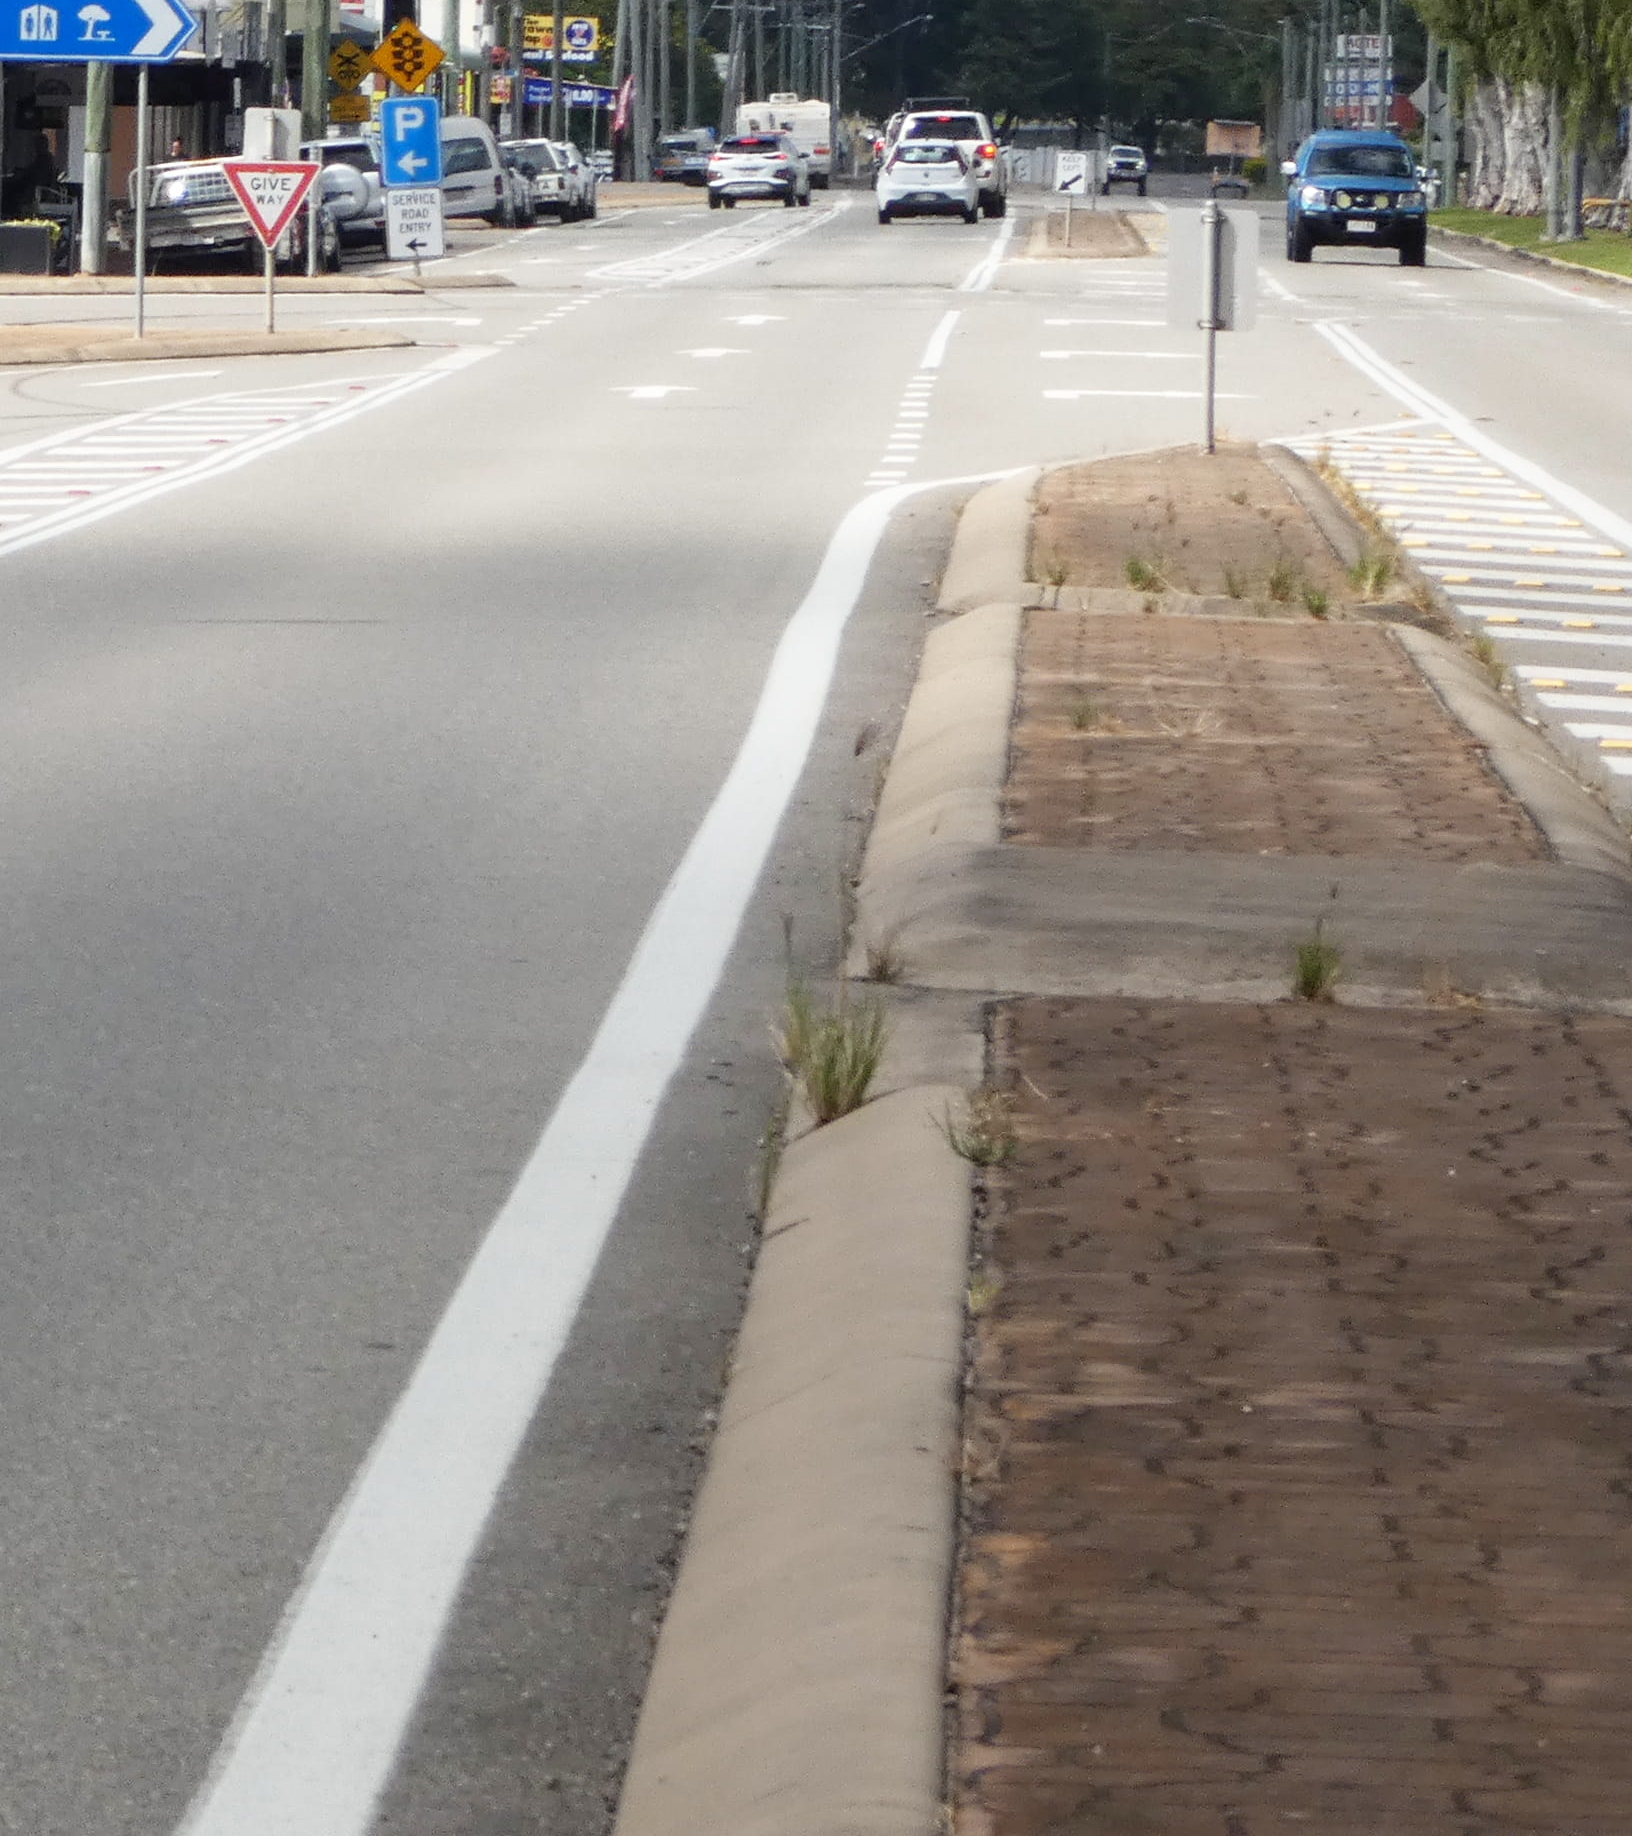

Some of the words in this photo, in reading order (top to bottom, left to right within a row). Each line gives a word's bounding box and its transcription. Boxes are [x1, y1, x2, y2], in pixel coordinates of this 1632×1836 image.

[394, 107, 424, 141] P
[251, 178, 291, 191] GIVE
[257, 195, 285, 204] WAY
[392, 193, 436, 205] SERVICE
[401, 208, 429, 219] ROAD
[400, 222, 432, 233] ENTRY
